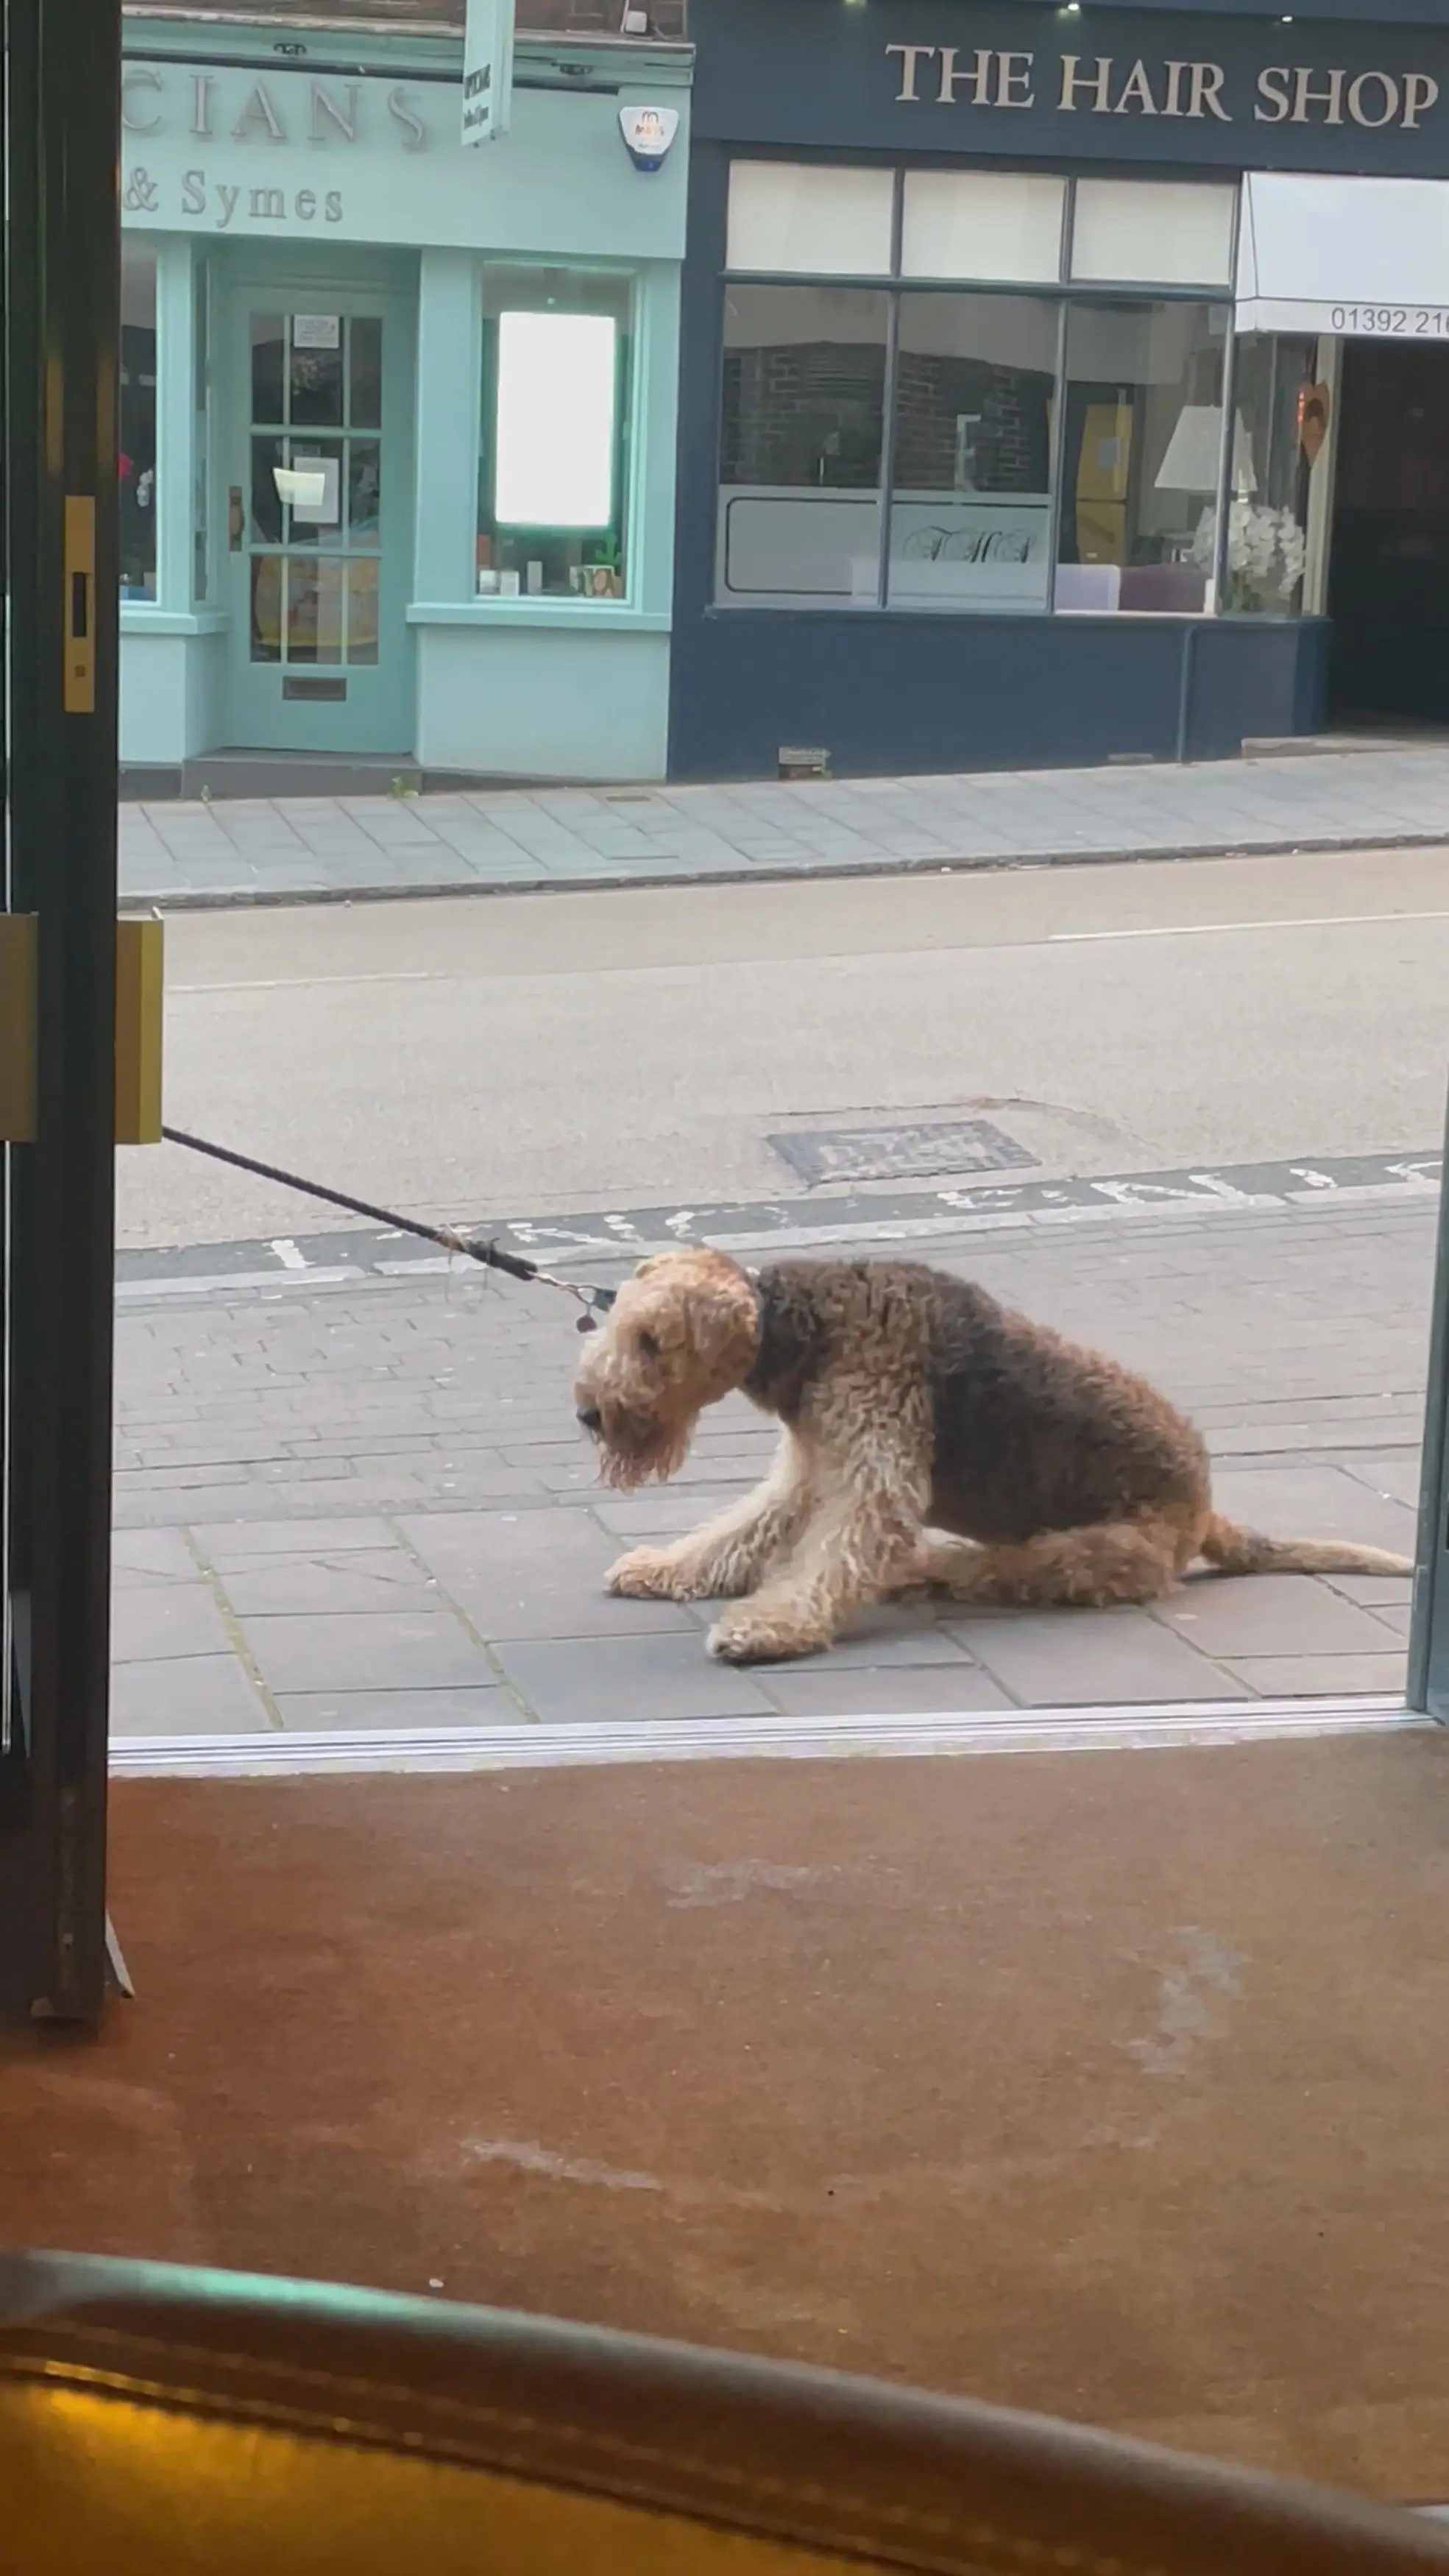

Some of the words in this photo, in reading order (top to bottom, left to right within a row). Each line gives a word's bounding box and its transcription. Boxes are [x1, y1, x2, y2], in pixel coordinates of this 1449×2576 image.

[121, 69, 428, 151] CIANS
[885, 43, 1035, 108] THE
[1056, 54, 1233, 122] HAIR
[1253, 66, 1439, 129] SHOP
[123, 166, 160, 212] &
[181, 169, 344, 228] Symes
[1331, 306, 1407, 333] 01392
